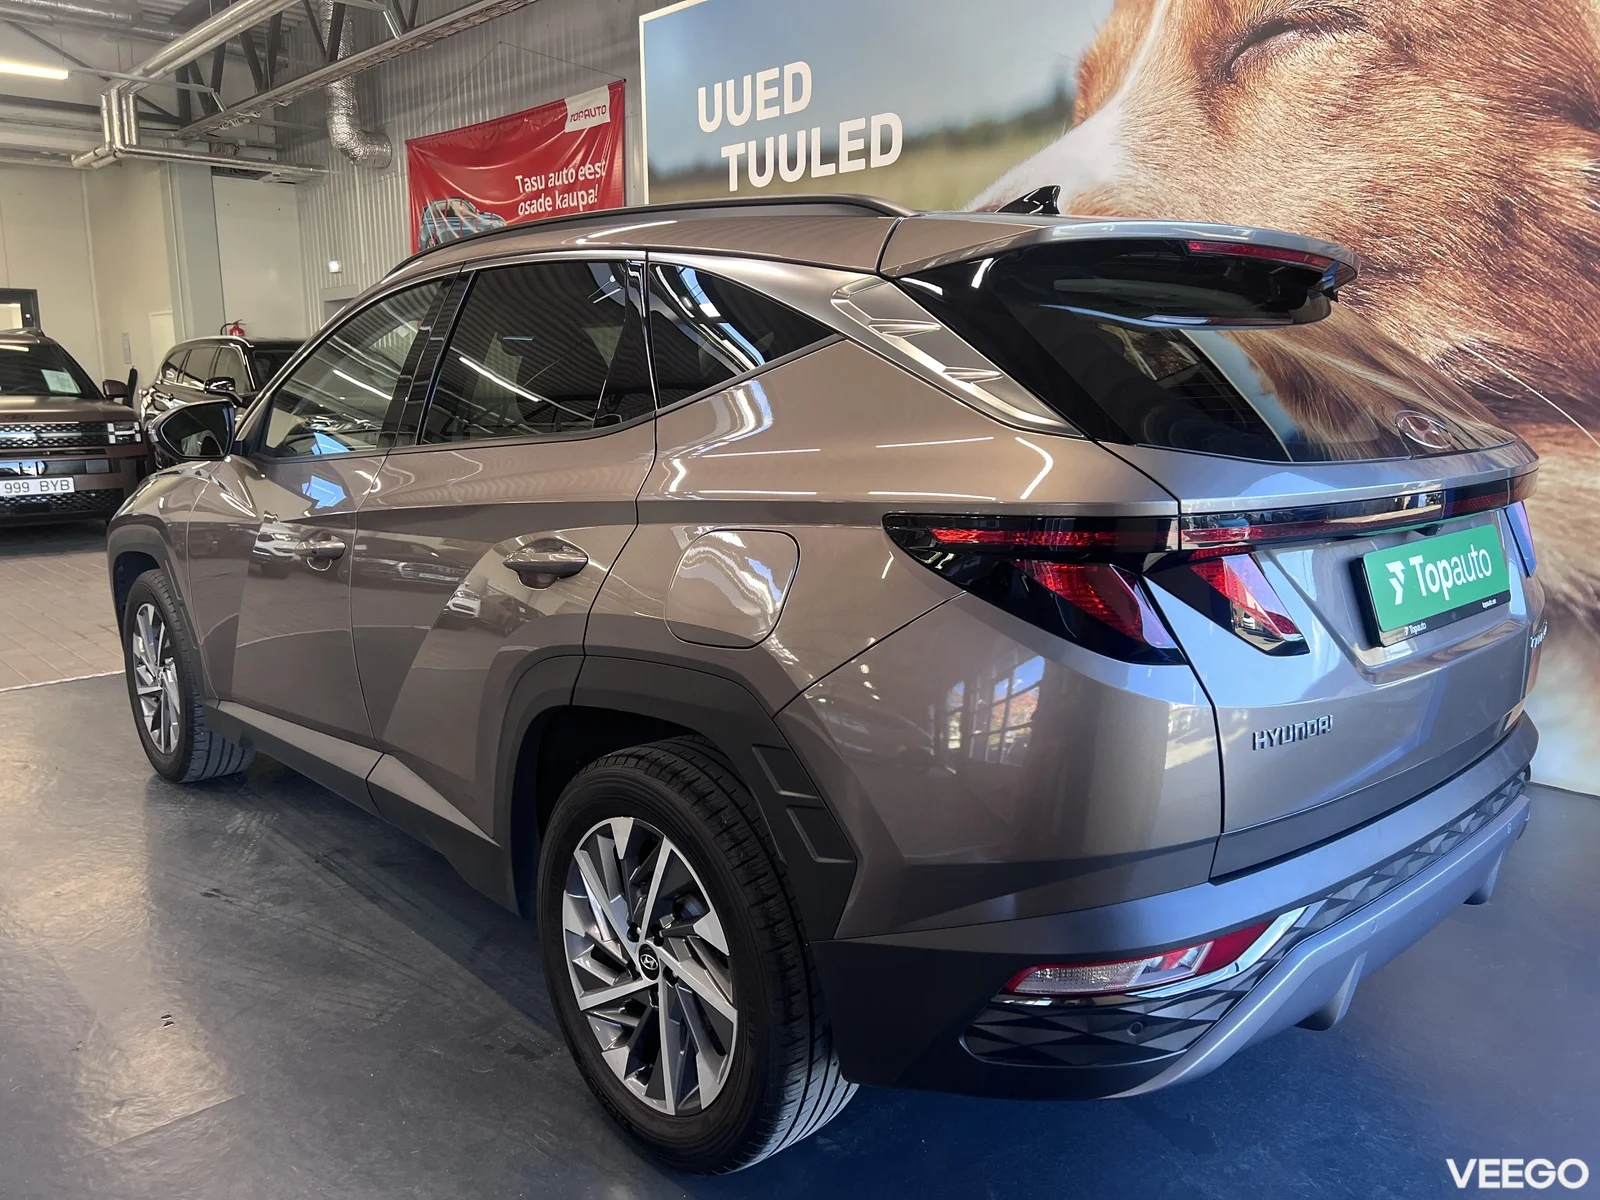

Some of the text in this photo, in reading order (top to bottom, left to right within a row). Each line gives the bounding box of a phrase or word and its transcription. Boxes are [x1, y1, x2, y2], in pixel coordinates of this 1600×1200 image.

[569, 104, 607, 123] TOPAUTO
[698, 61, 812, 133] UUED
[721, 112, 903, 192] TUULED
[515, 160, 606, 194] Tasu auto eest
[518, 185, 598, 216] osade kaupa!
[4, 480, 70, 494] 999 BYB
[1408, 544, 1492, 601] Topauto
[1409, 621, 1427, 635] Topauto
[1252, 714, 1334, 751] HYUNDAI
